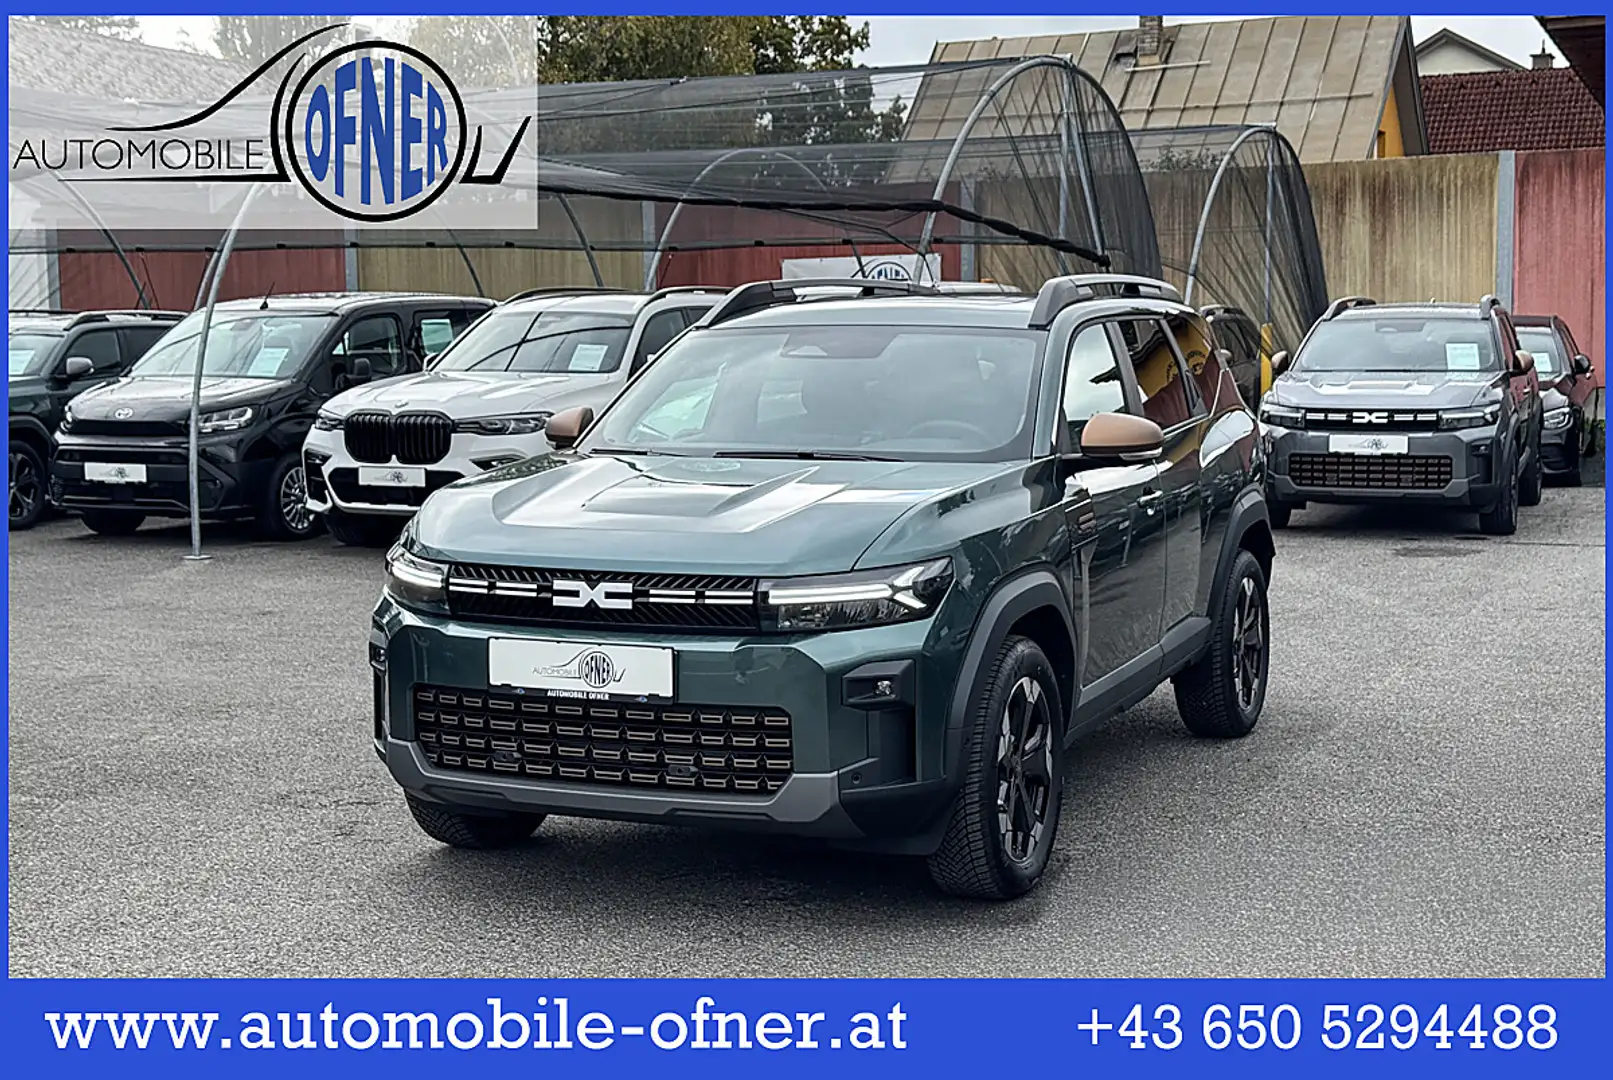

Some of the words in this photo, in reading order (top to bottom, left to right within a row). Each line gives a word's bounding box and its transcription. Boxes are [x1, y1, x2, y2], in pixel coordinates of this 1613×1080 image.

[583, 654, 612, 685] OFNER
[547, 689, 587, 699] AUTOMOBILE
[588, 691, 610, 701] OFNER
